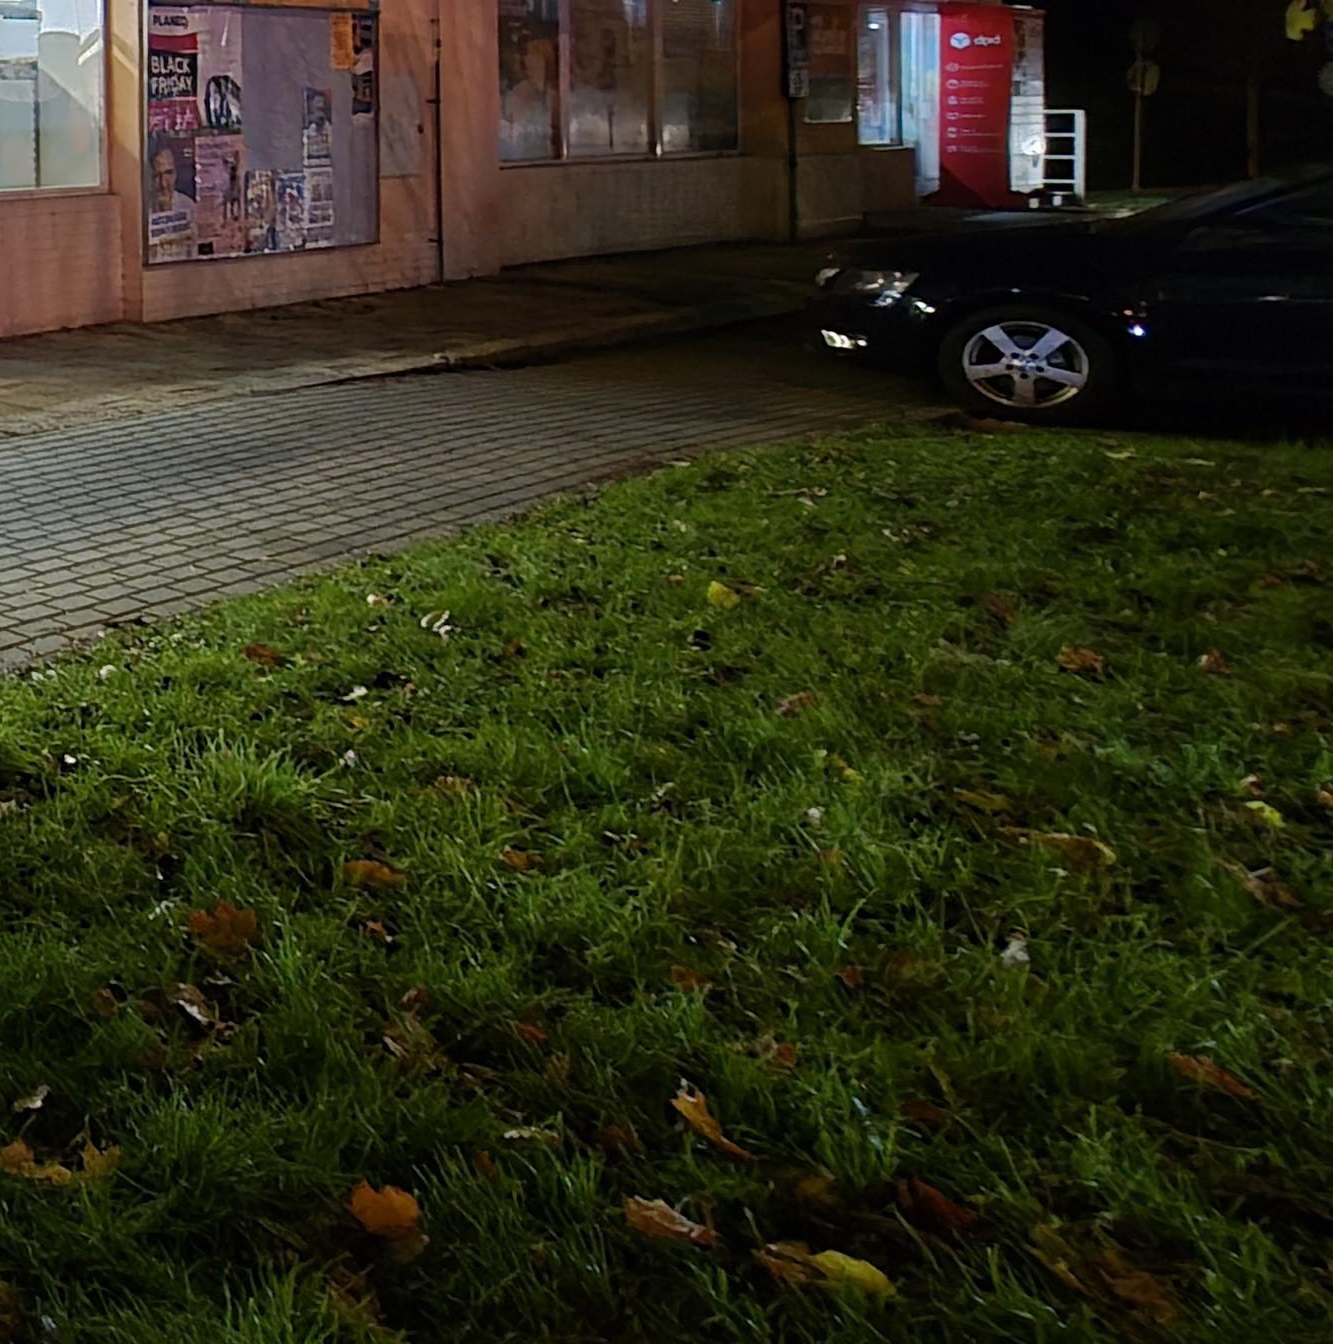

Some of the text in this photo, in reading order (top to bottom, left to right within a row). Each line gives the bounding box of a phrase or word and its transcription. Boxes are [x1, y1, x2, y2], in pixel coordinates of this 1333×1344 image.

[973, 34, 1002, 47] dpd
[151, 55, 191, 74] BLACK
[150, 76, 193, 96] FRIDAY
